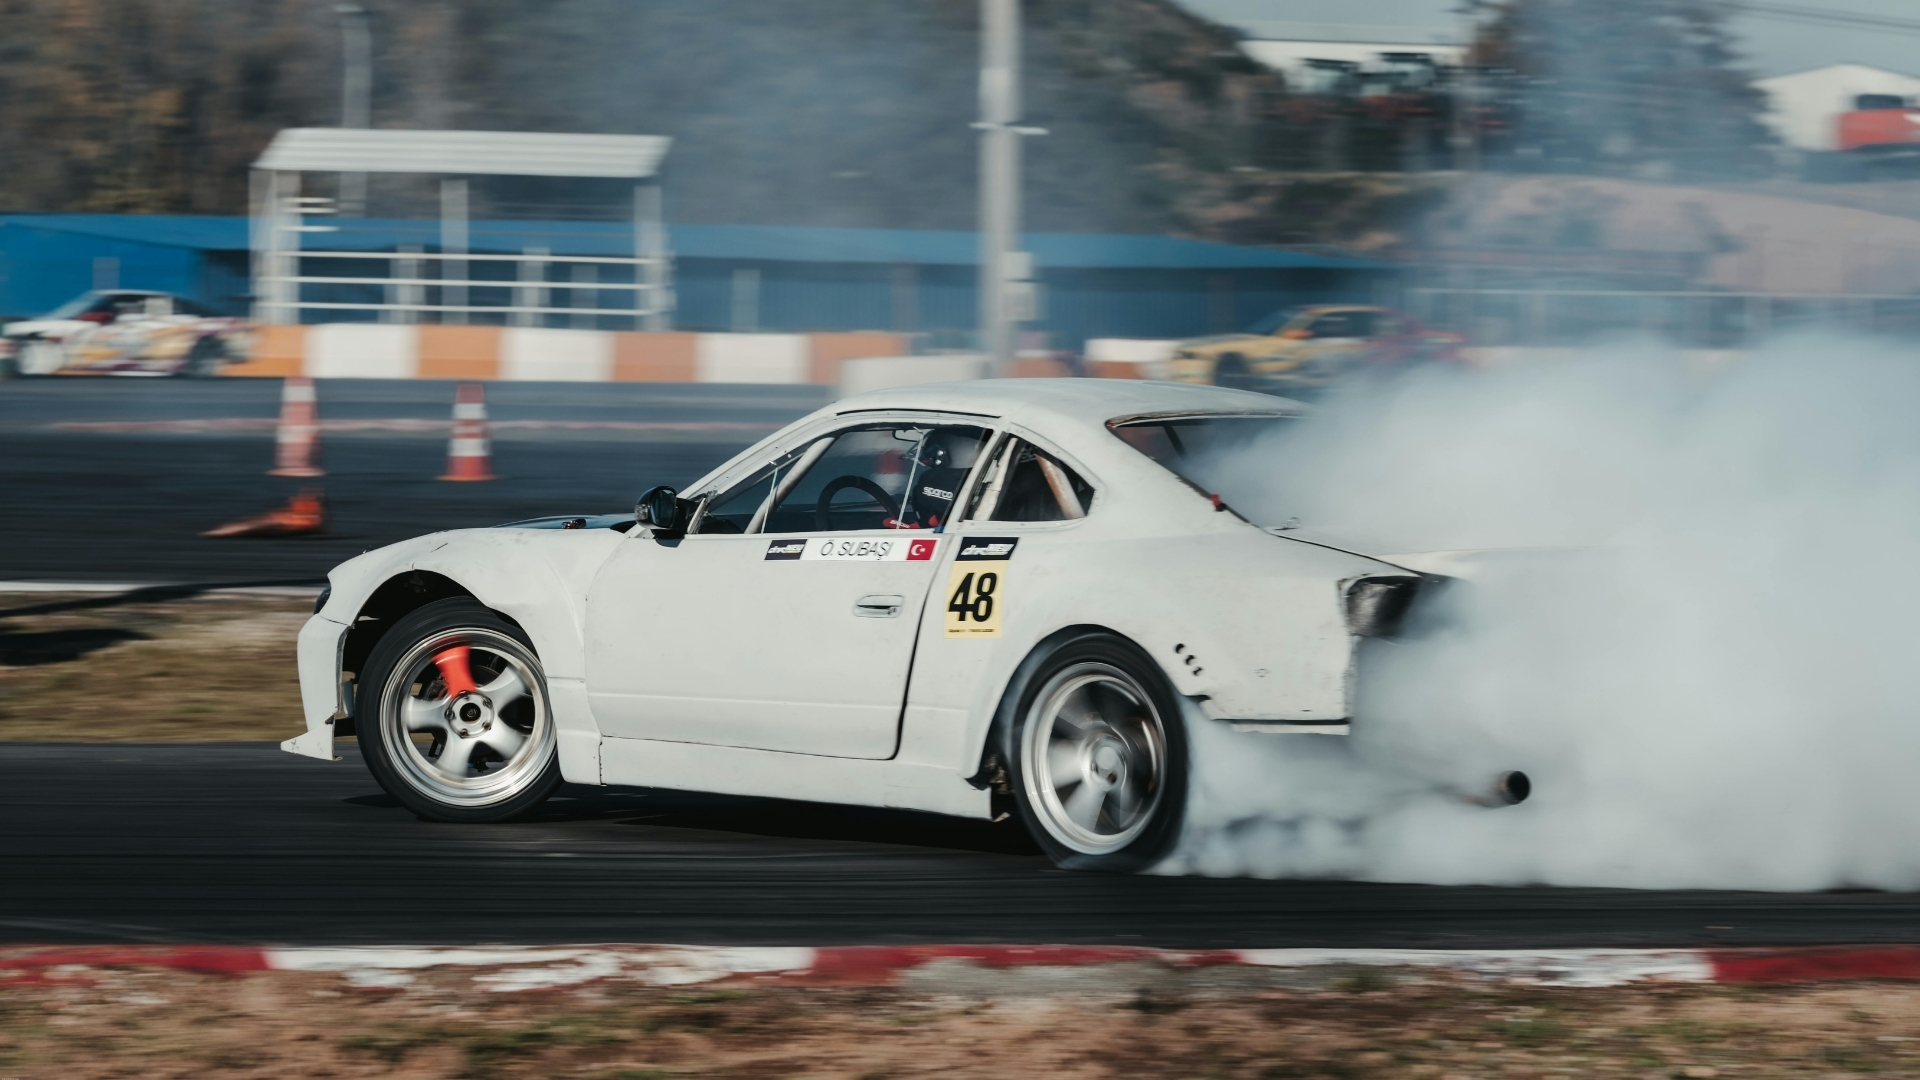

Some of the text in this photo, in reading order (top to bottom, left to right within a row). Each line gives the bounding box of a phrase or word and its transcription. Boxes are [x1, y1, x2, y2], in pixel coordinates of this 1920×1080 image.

[820, 539, 834, 556] Ö.
[838, 541, 895, 561] SUBAŞI
[948, 572, 998, 623] 48
